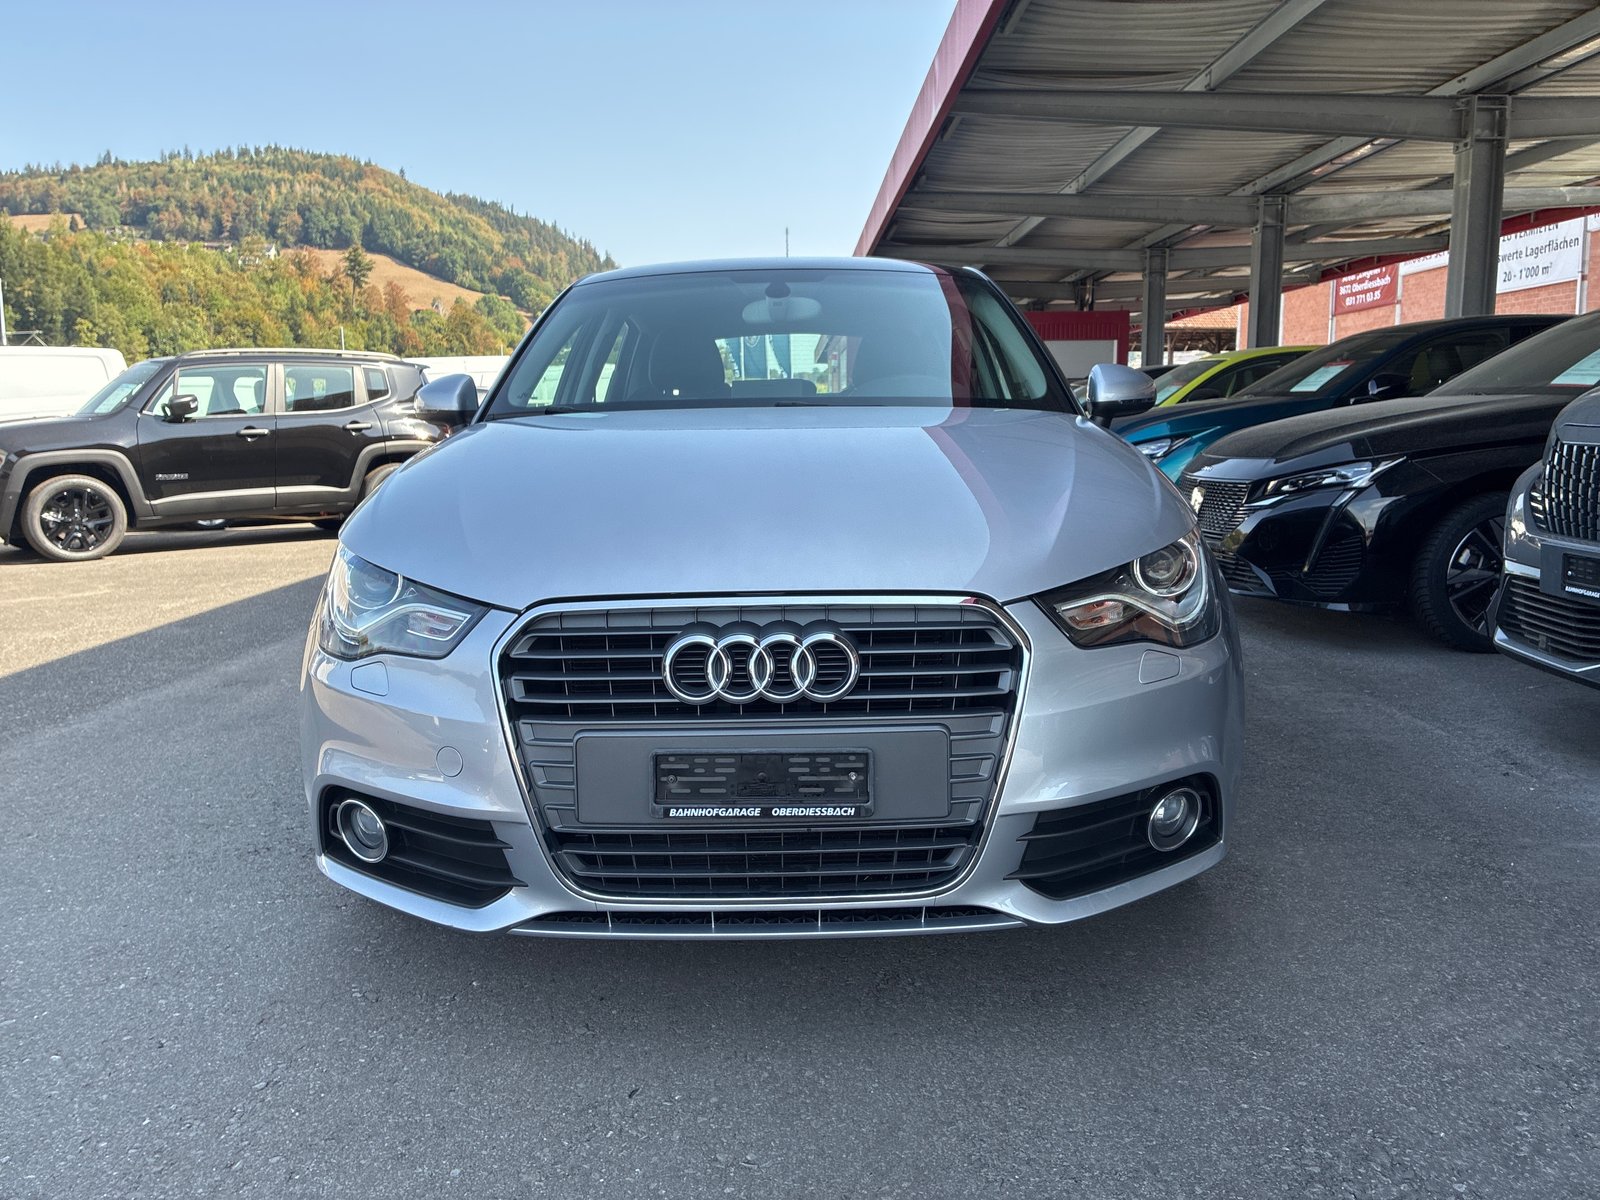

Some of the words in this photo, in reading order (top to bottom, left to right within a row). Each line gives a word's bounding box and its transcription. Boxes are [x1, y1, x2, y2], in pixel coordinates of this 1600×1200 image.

[1525, 237, 1580, 258] Lagerflächen
[1503, 271, 1512, 282] 20
[669, 807, 761, 817] BAHNHOFGARAGE
[771, 807, 856, 816] OBERDIESSBACH
